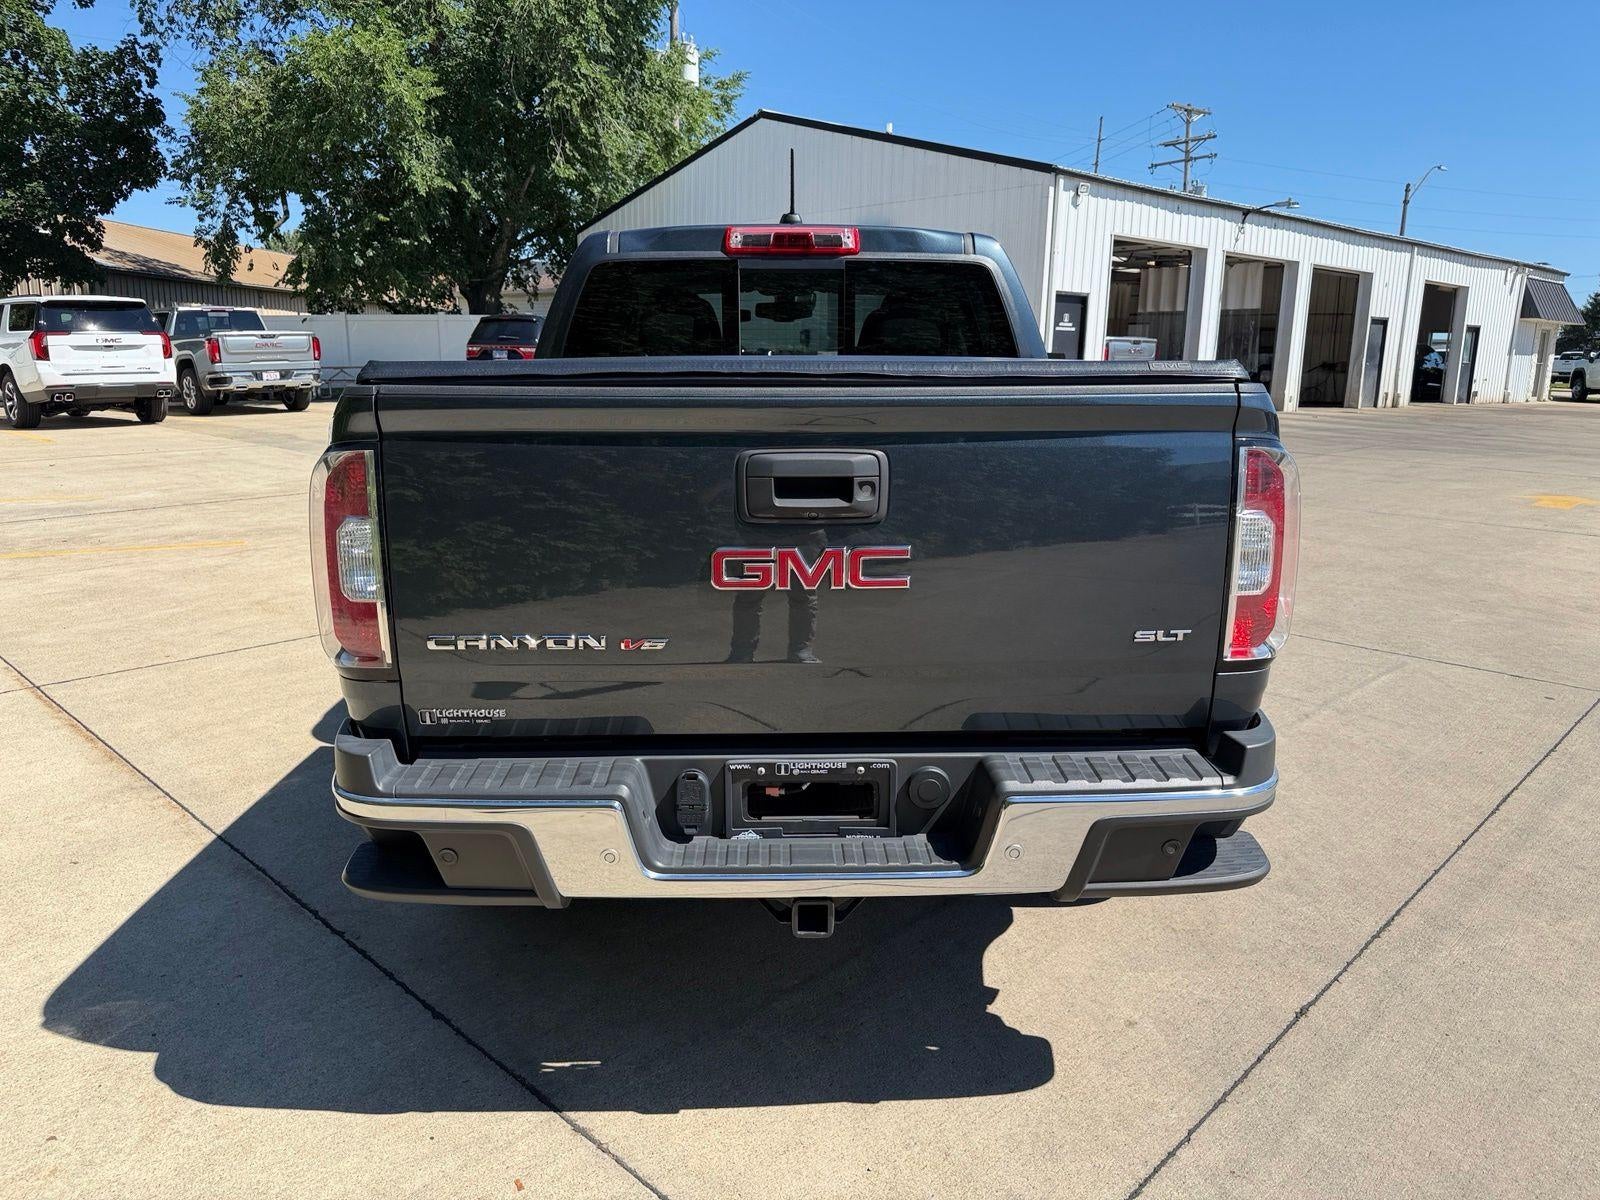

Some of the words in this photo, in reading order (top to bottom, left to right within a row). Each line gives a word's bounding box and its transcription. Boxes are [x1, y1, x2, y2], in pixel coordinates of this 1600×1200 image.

[1152, 362, 1191, 370] GMC
[711, 545, 911, 590] GMC
[1134, 629, 1192, 642] SLT
[426, 635, 607, 650] CANYON
[620, 638, 669, 650] V6
[436, 709, 507, 718] LIGHTHOUSE
